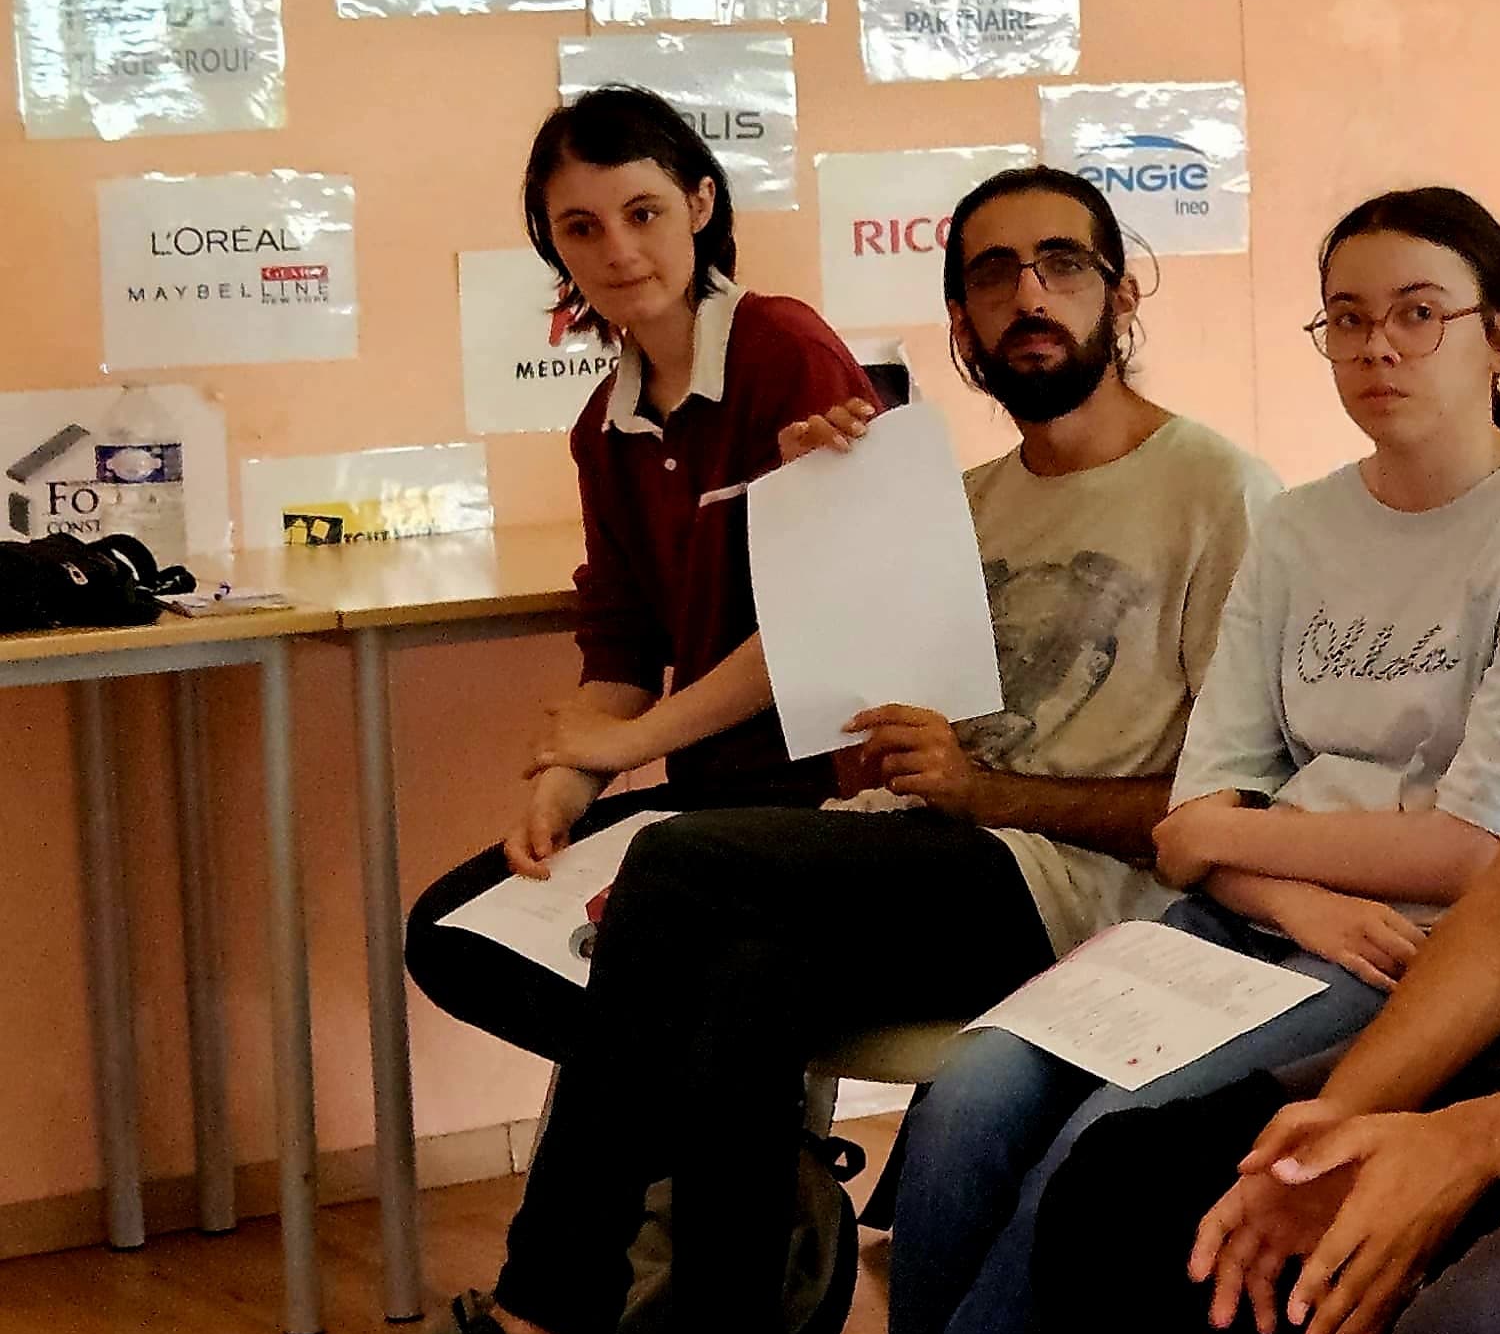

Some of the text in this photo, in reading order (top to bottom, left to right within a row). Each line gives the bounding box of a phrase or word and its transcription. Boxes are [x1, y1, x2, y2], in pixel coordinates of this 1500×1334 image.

[1175, 198, 1209, 215] Ineo
[151, 225, 300, 256] L'ORÉAL
[127, 281, 329, 302] MAYBELLINE
